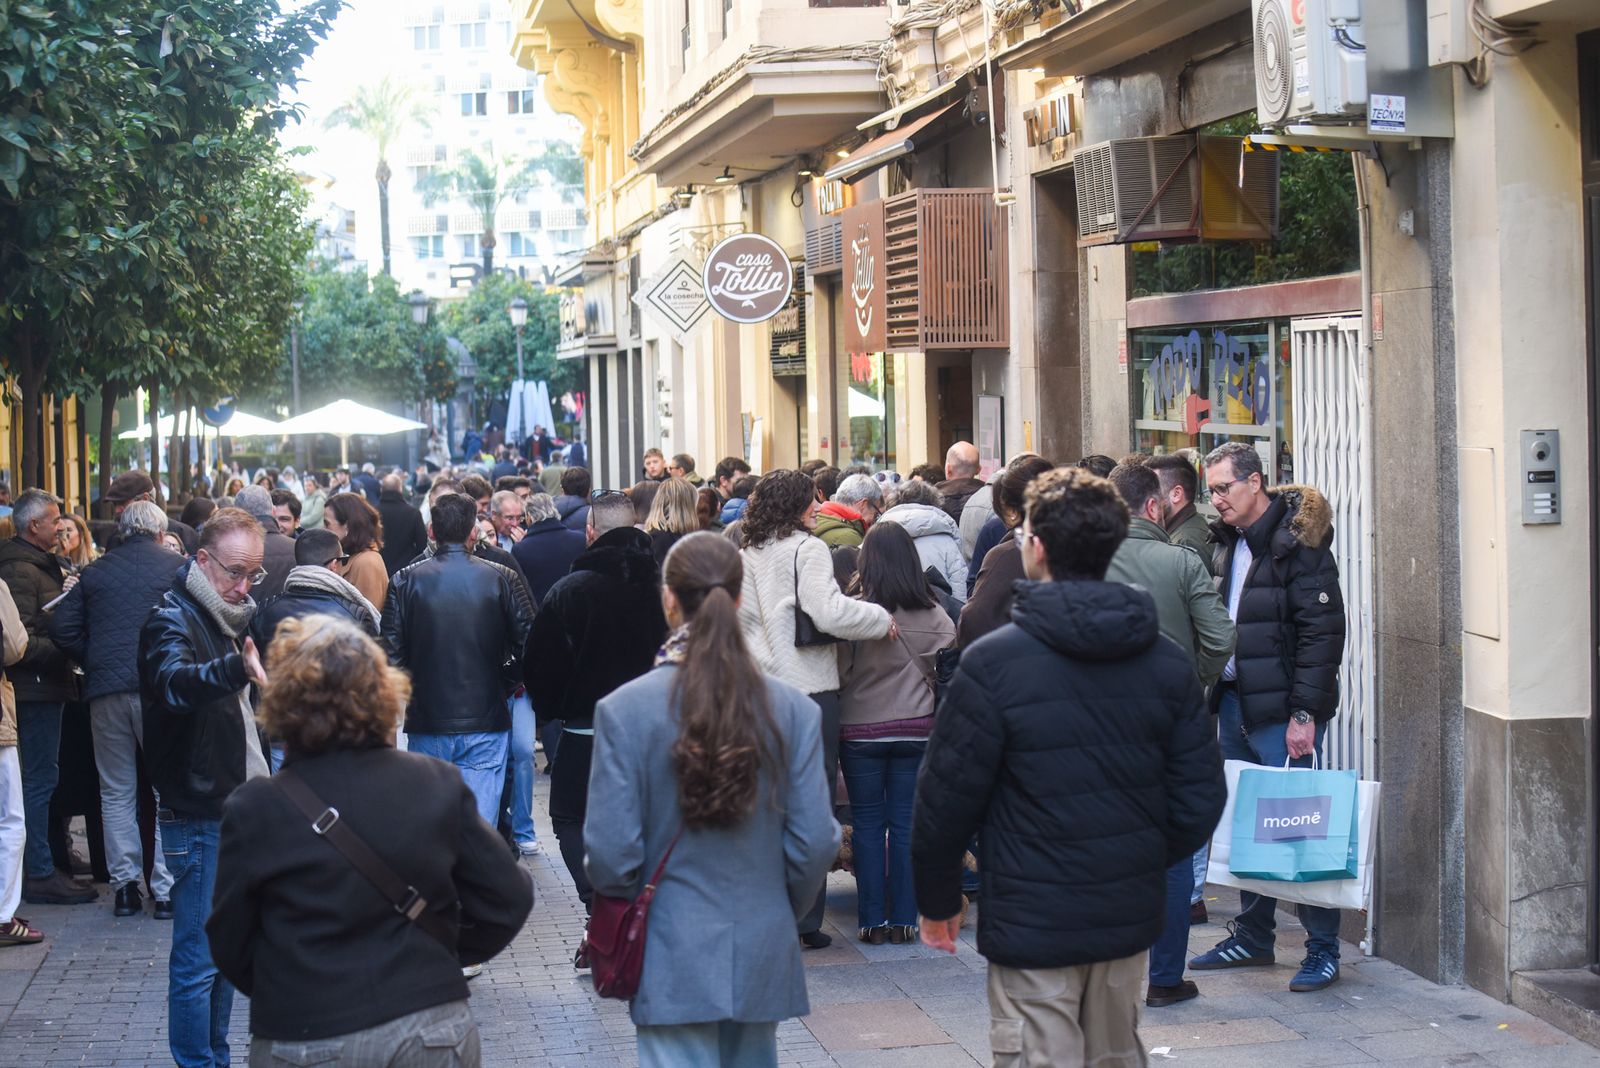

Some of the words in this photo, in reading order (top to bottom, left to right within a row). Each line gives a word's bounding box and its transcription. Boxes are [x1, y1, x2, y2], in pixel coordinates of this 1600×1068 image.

[1023, 93, 1076, 148] TOLLIN
[1373, 108, 1404, 120] TECNYA
[735, 253, 773, 266] casa
[711, 262, 785, 300] Tollin
[1149, 329, 1202, 415] TODO
[1263, 811, 1322, 828] moonë
